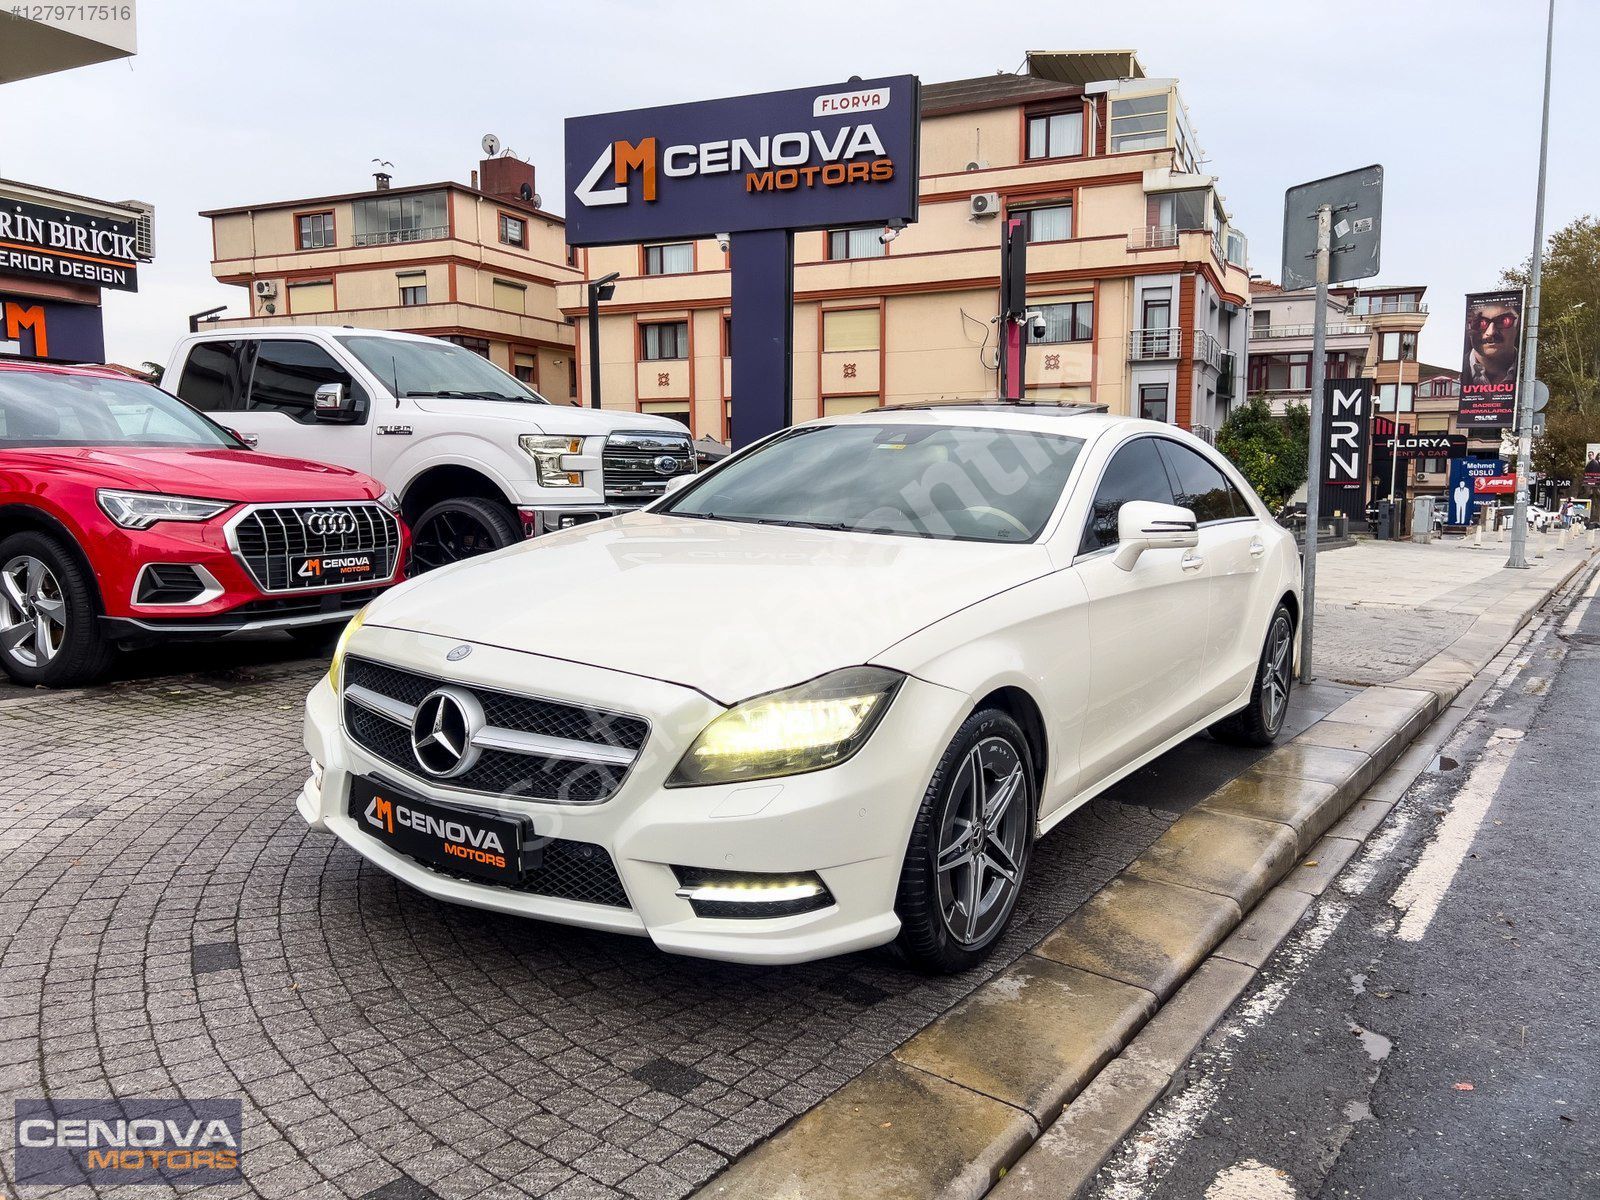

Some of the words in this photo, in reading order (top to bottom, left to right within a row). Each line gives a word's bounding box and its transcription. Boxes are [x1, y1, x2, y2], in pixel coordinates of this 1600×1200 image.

[822, 93, 881, 112] FLORYA
[663, 123, 888, 177] CENOVA
[746, 159, 894, 192] MOTORS
[48, 215, 138, 260] BİRİCİK
[60, 260, 126, 284] DESIGN
[1463, 383, 1514, 393] UYKUCU
[1329, 388, 1362, 479] MRN
[1387, 439, 1451, 448] FLORYA
[322, 556, 370, 568] CENOVA
[340, 566, 370, 574] MOTORS
[395, 805, 504, 854] CENOVA
[443, 843, 507, 868] MOTORS
